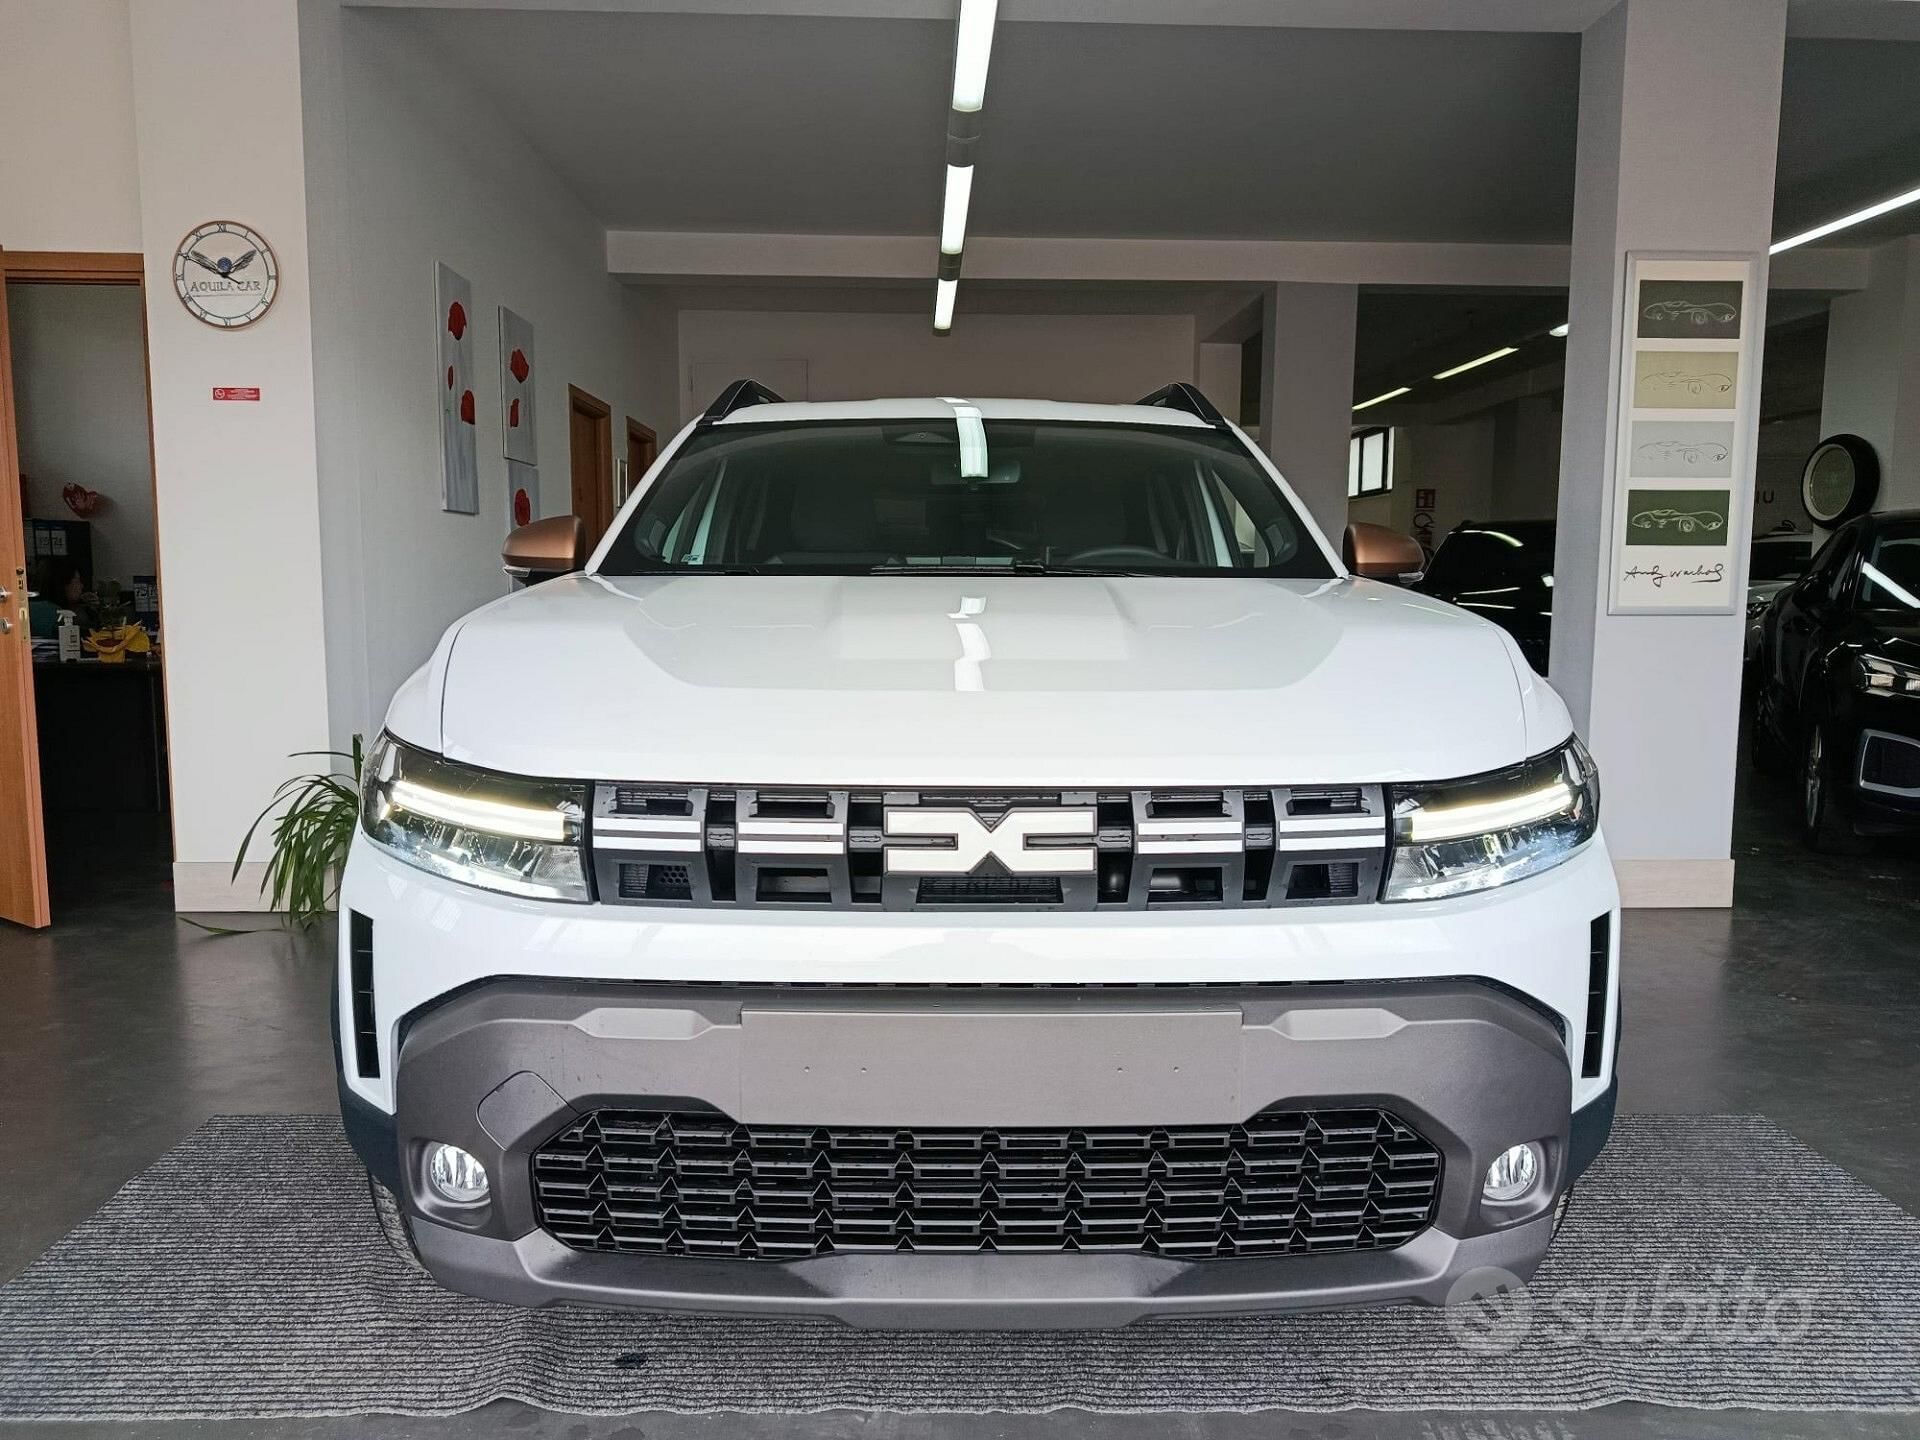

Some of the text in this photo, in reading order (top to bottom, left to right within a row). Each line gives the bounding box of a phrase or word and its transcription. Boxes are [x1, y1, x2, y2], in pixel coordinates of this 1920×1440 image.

[190, 280, 261, 293] AQUILA CAR
[1624, 565, 1667, 588] Andy
